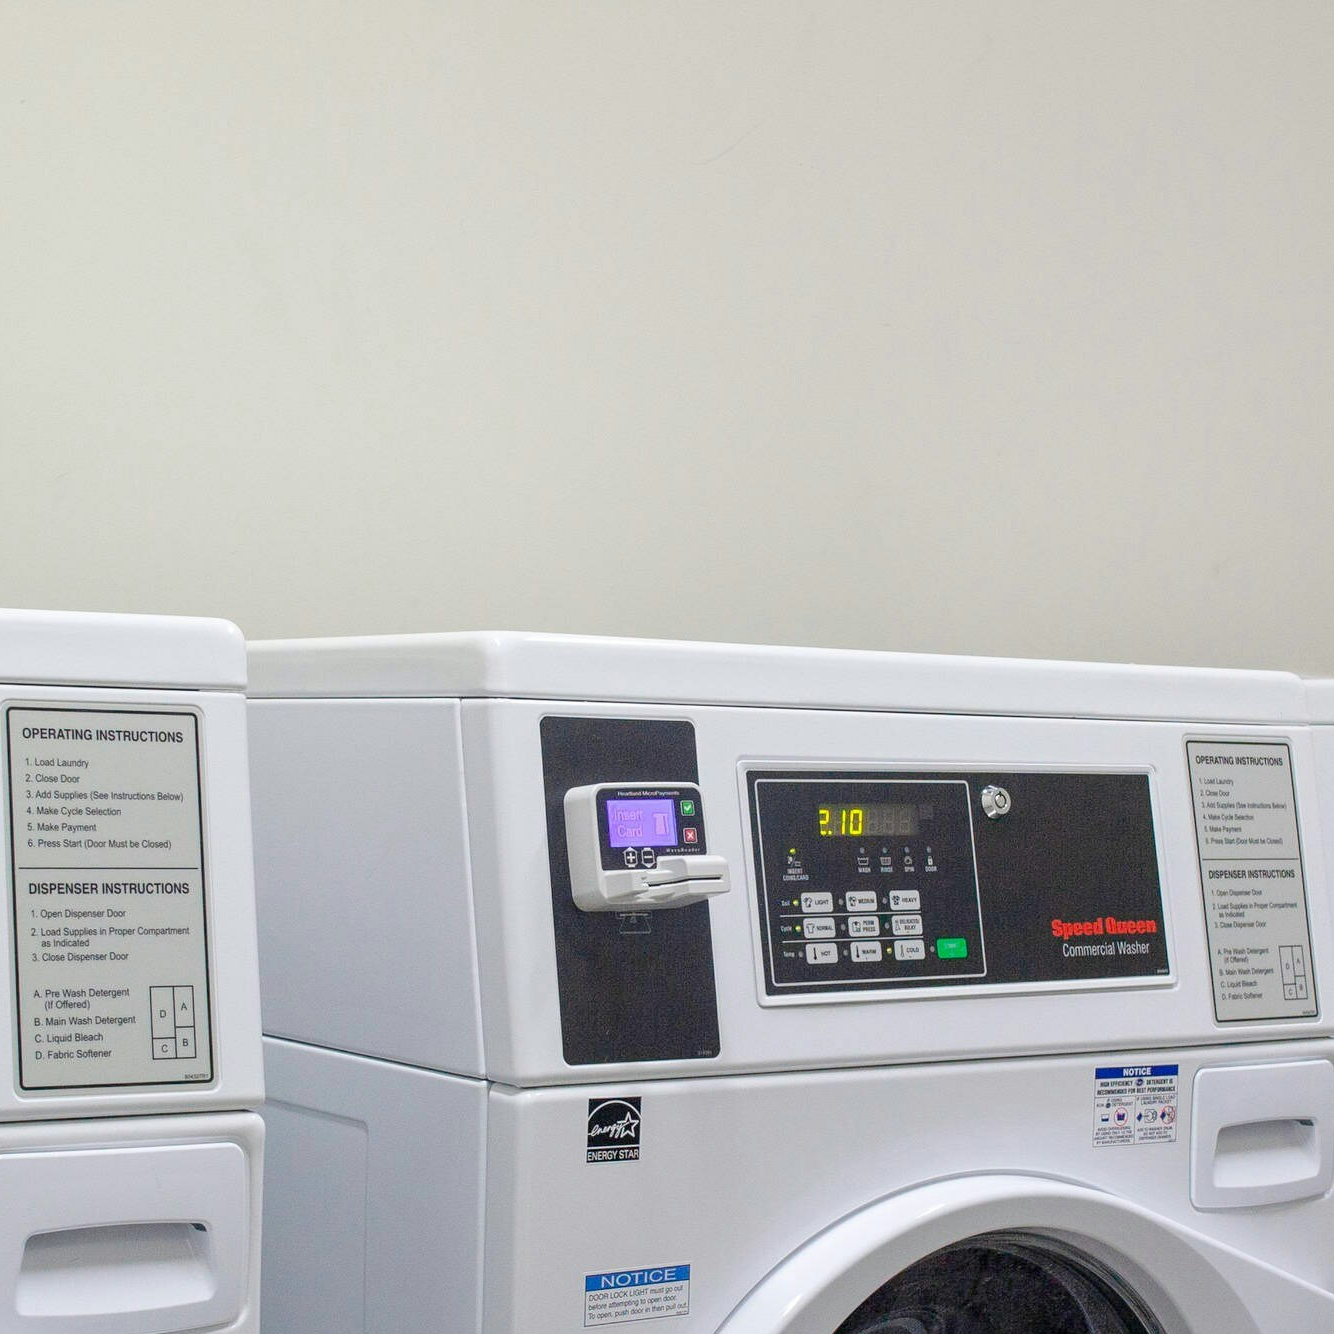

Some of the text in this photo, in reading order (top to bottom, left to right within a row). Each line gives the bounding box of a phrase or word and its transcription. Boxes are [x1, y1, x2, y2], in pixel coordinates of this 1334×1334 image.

[23, 728, 183, 743] OPERATING INSTRUCTIONS
[35, 758, 54, 766] Load
[57, 759, 88, 768] Laundry
[1196, 756, 1283, 766] OPERATING INSTRUCTIONS
[36, 774, 58, 783] Close
[61, 775, 80, 783] Door
[36, 791, 51, 799] Add
[54, 791, 87, 801] Supplies
[90, 792, 108, 801] (See
[111, 792, 155, 800] Instructions
[158, 792, 183, 802] Below)
[61, 807, 83, 817] Cycle
[819, 809, 863, 836] 2.10
[27, 823, 34, 831] 5.
[62, 824, 96, 833] Payment
[38, 839, 60, 847] Press
[63, 840, 82, 848] Start
[84, 840, 106, 849] (Door
[109, 840, 127, 848] Must
[130, 840, 139, 848] be
[142, 840, 171, 849] Closed)
[1209, 869, 1295, 879] DISPENSER INSTRUCTIONS
[29, 883, 189, 894] DISPENSER INSTRUCTIONS
[41, 910, 62, 920] Open
[65, 910, 105, 919] Dispenser
[107, 909, 126, 917] Door
[41, 928, 61, 936] Load
[64, 928, 97, 938] Supplies
[109, 928, 135, 937] Proper
[138, 927, 189, 937] Compartment
[1052, 917, 1157, 939] Speed Queen
[54, 939, 89, 947] Indicated
[1063, 942, 1150, 957] Commercial Washer
[42, 953, 65, 961] Close
[68, 953, 107, 963] Dispenser
[34, 988, 129, 999] A. Pre Wash Detergent
[45, 1001, 90, 1010] (If Offered)
[160, 1010, 166, 1018] D
[35, 1016, 136, 1027] B. Main Wash Detergent
[35, 1034, 103, 1044] C. Liquid Bleach
[35, 1050, 111, 1059] D. Fabric Softener
[1123, 1068, 1151, 1076] NOTICE
[588, 1149, 639, 1161] ENERGY STAR
[601, 1268, 677, 1288] NOTICE
